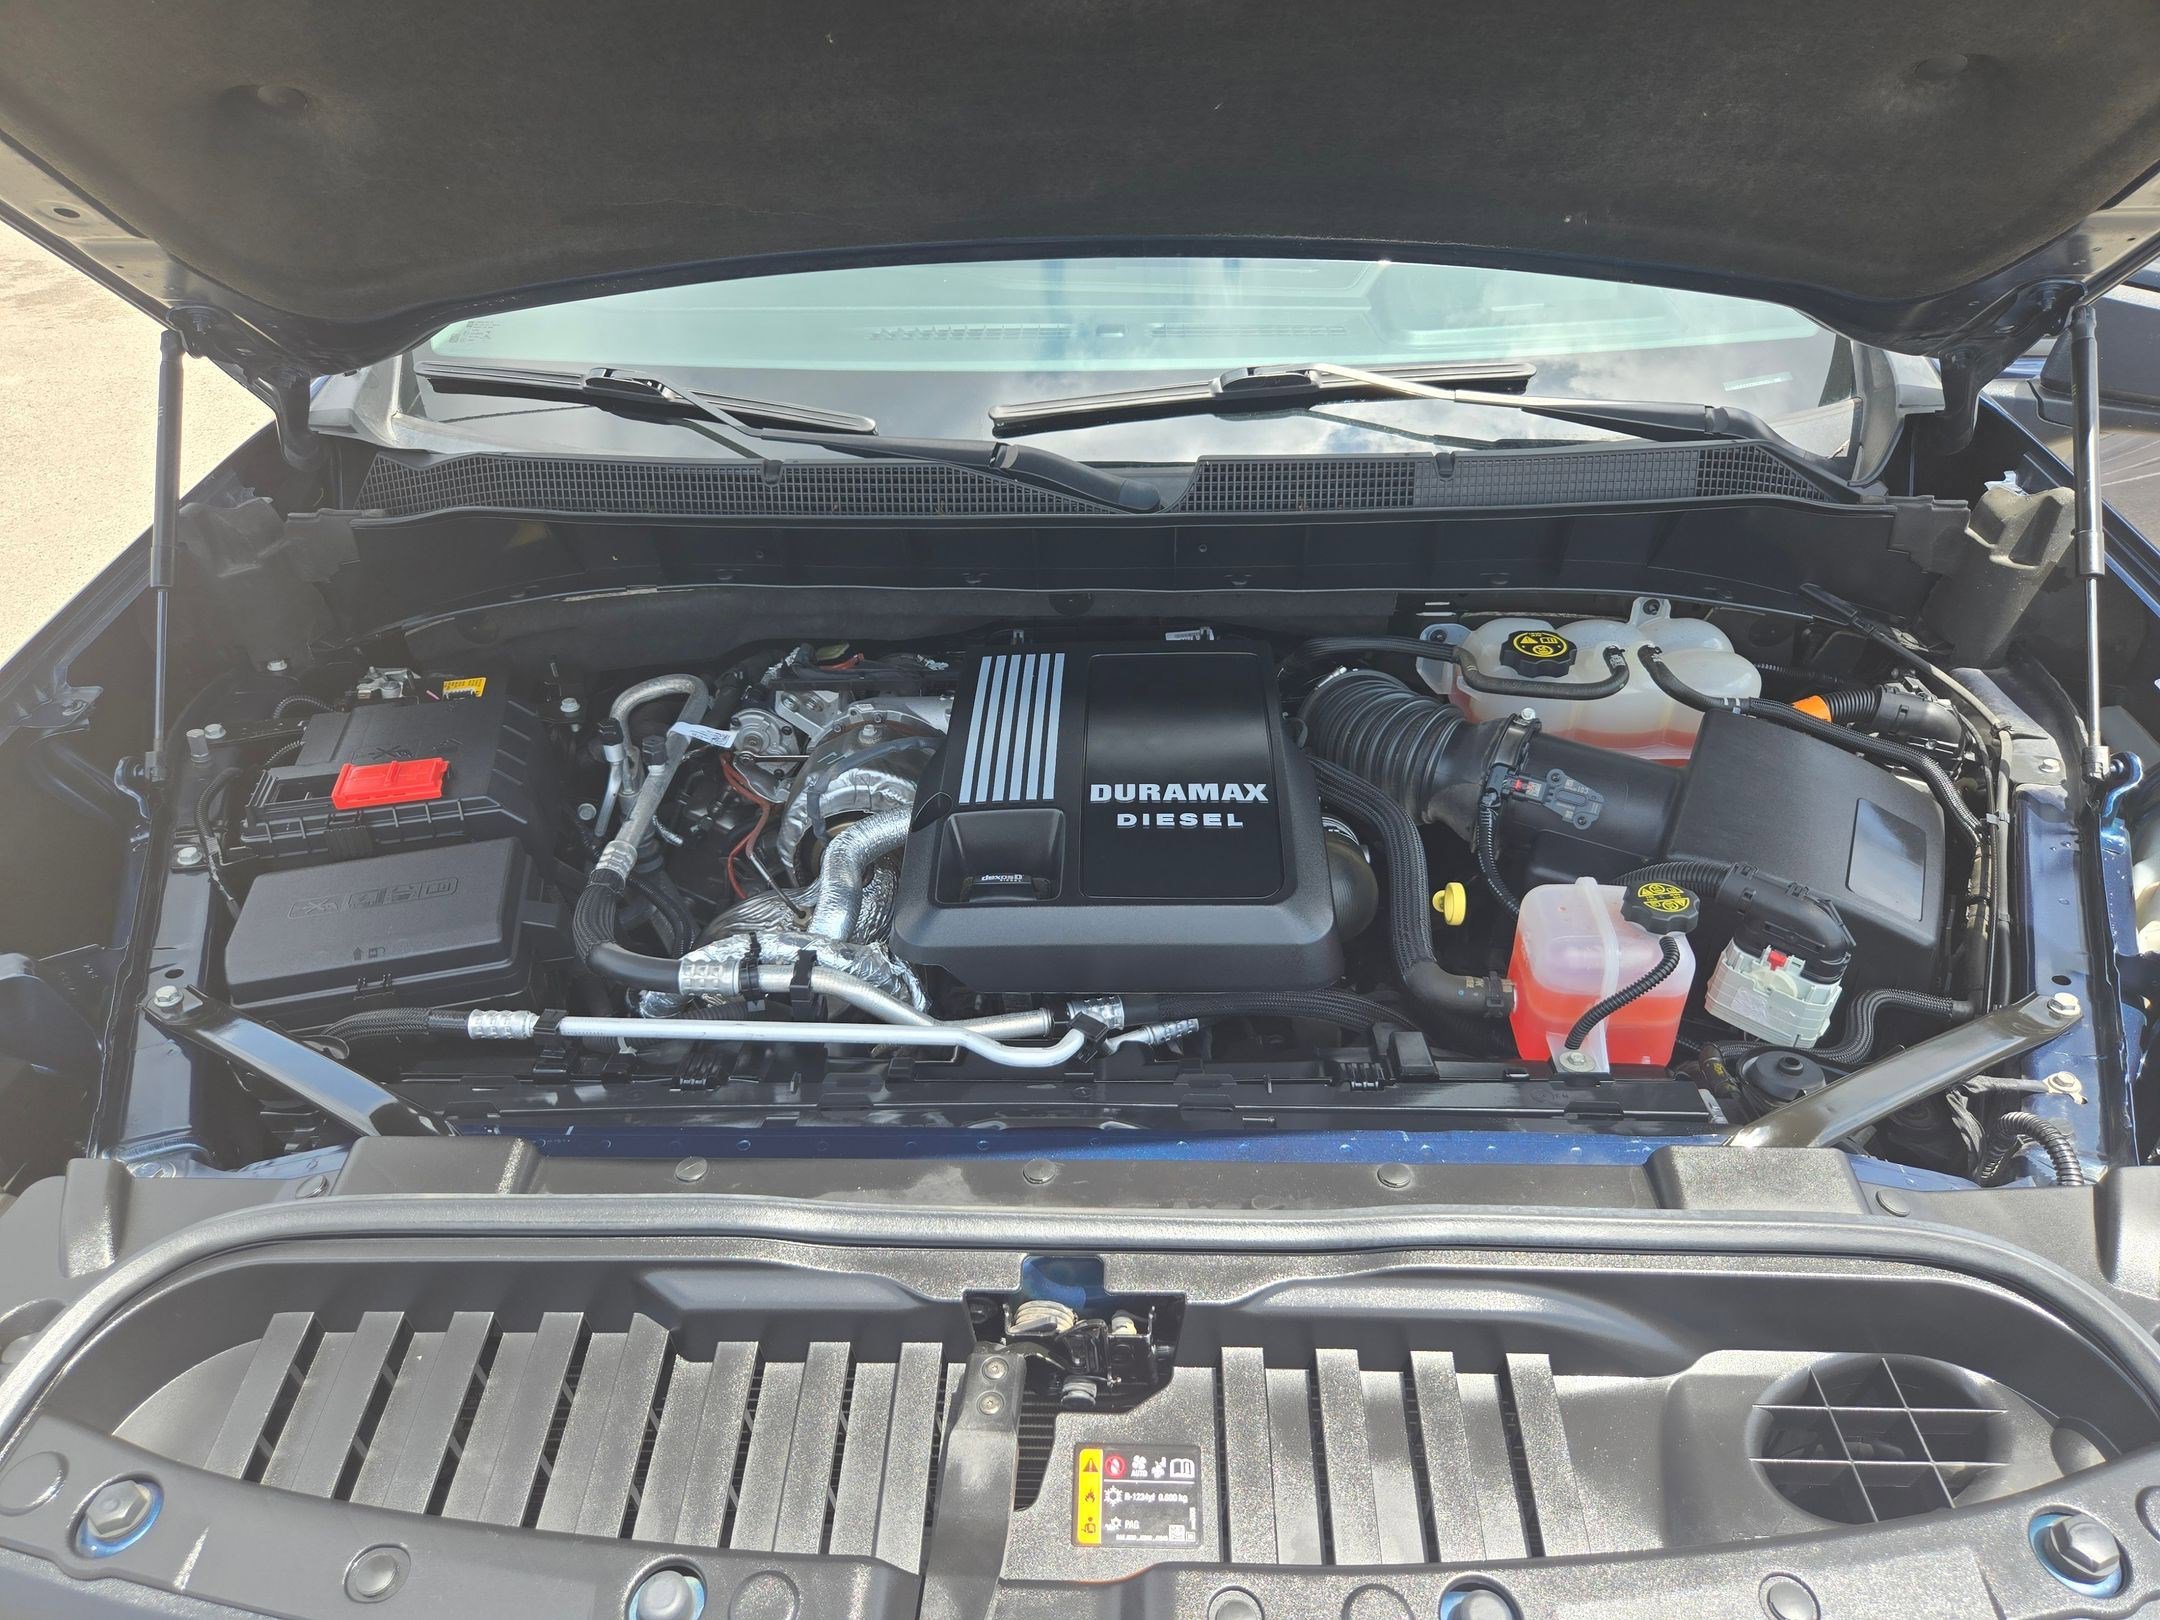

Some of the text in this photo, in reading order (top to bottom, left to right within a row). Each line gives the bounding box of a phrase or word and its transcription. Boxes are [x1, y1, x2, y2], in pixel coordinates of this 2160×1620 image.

[1090, 783, 1268, 803] DURAMAX
[1117, 813, 1244, 828] DIESEL
[1124, 1492, 1156, 1503] R-1234yf
[1179, 1494, 1188, 1504] kg
[1124, 1520, 1140, 1530] PAG
